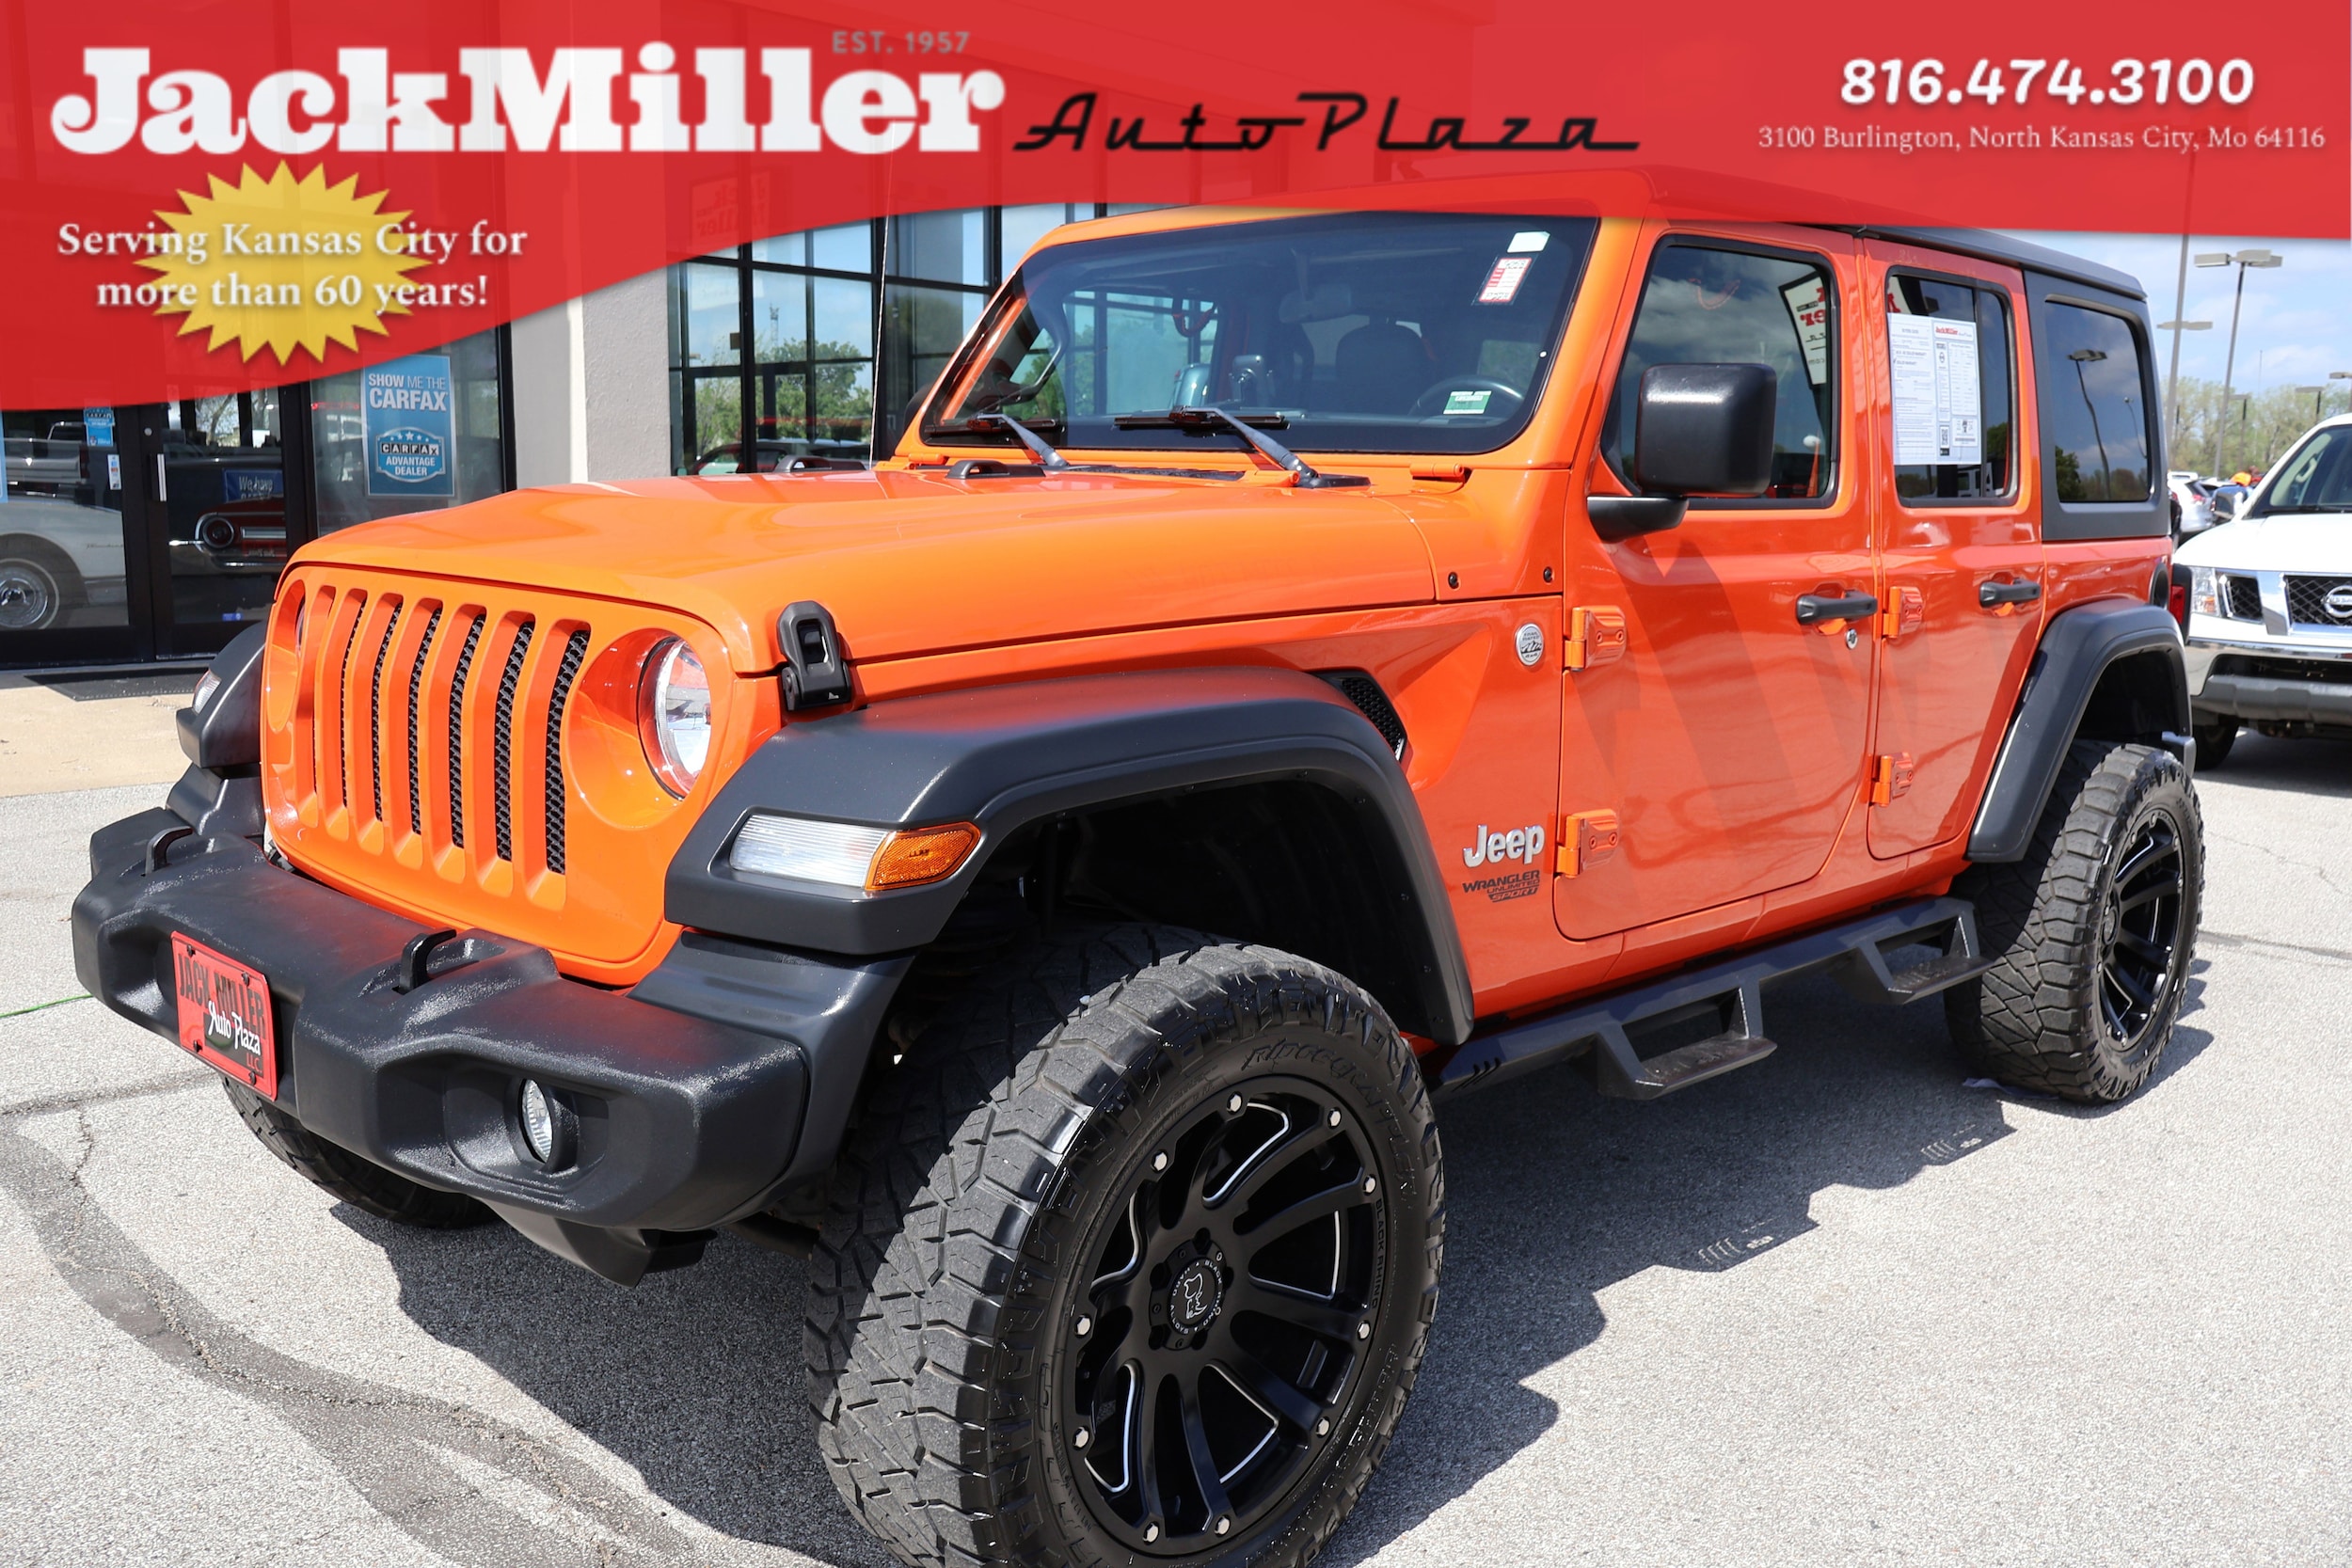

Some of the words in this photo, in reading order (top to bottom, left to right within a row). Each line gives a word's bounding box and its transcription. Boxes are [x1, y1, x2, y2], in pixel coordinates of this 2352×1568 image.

[369, 372, 404, 388] SHOW
[407, 375, 423, 389] ME
[426, 376, 446, 390] THE
[369, 388, 447, 412] CARFAX
[381, 442, 439, 456] CARFAX
[386, 455, 437, 467] ADVANTAGE
[238, 475, 255, 491] We
[255, 476, 274, 491] have
[394, 466, 428, 477] DEALER
[1462, 824, 1546, 868] Jeep
[1462, 869, 1541, 894] WRANGLER
[1486, 879, 1540, 895] UNLIMITED
[178, 953, 211, 1012] JACK
[208, 1000, 232, 1039] Auto
[231, 1011, 262, 1056] Plaza
[246, 1052, 262, 1073] LLC
[1375, 1197, 1385, 1251] BLACK
[1204, 1259, 1223, 1285] BLACK
[1371, 1255, 1384, 1309] RHINO
[1170, 1304, 1189, 1335] ALLOYS
